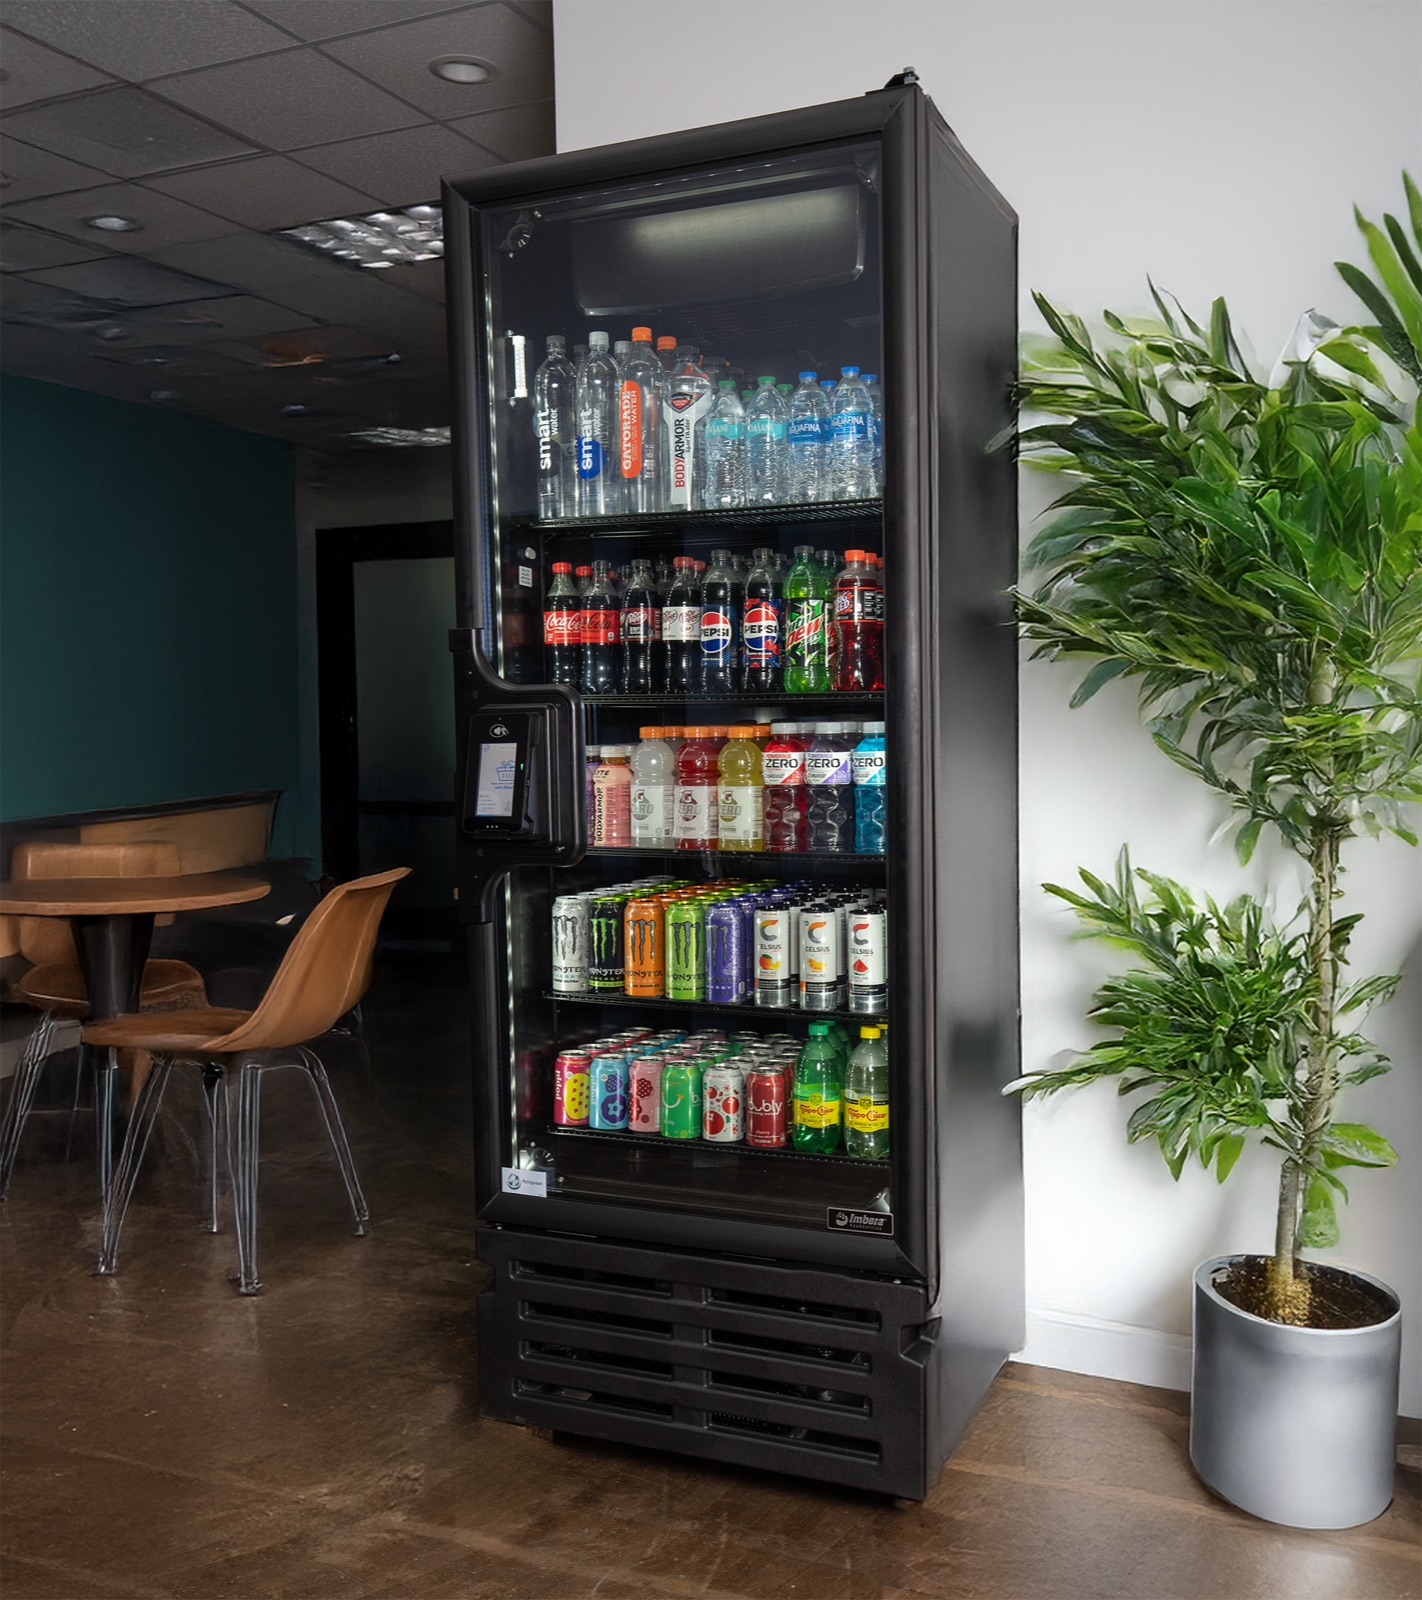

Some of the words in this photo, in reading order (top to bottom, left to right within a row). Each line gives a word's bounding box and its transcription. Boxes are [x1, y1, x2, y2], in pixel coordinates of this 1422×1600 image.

[550, 408, 559, 436] water
[593, 408, 601, 436] water
[707, 423, 729, 434] ASANI
[622, 390, 632, 471] GATORADE
[537, 408, 552, 470] smart
[580, 408, 593, 470] smart
[675, 418, 686, 488] BODYARMOR
[744, 624, 778, 634] PEPSI
[765, 758, 799, 768] ZERO
[807, 758, 841, 768] ZERO
[853, 757, 884, 767] ZERO
[553, 965, 587, 974] ONSTER
[848, 1213, 885, 1227] Imbera
